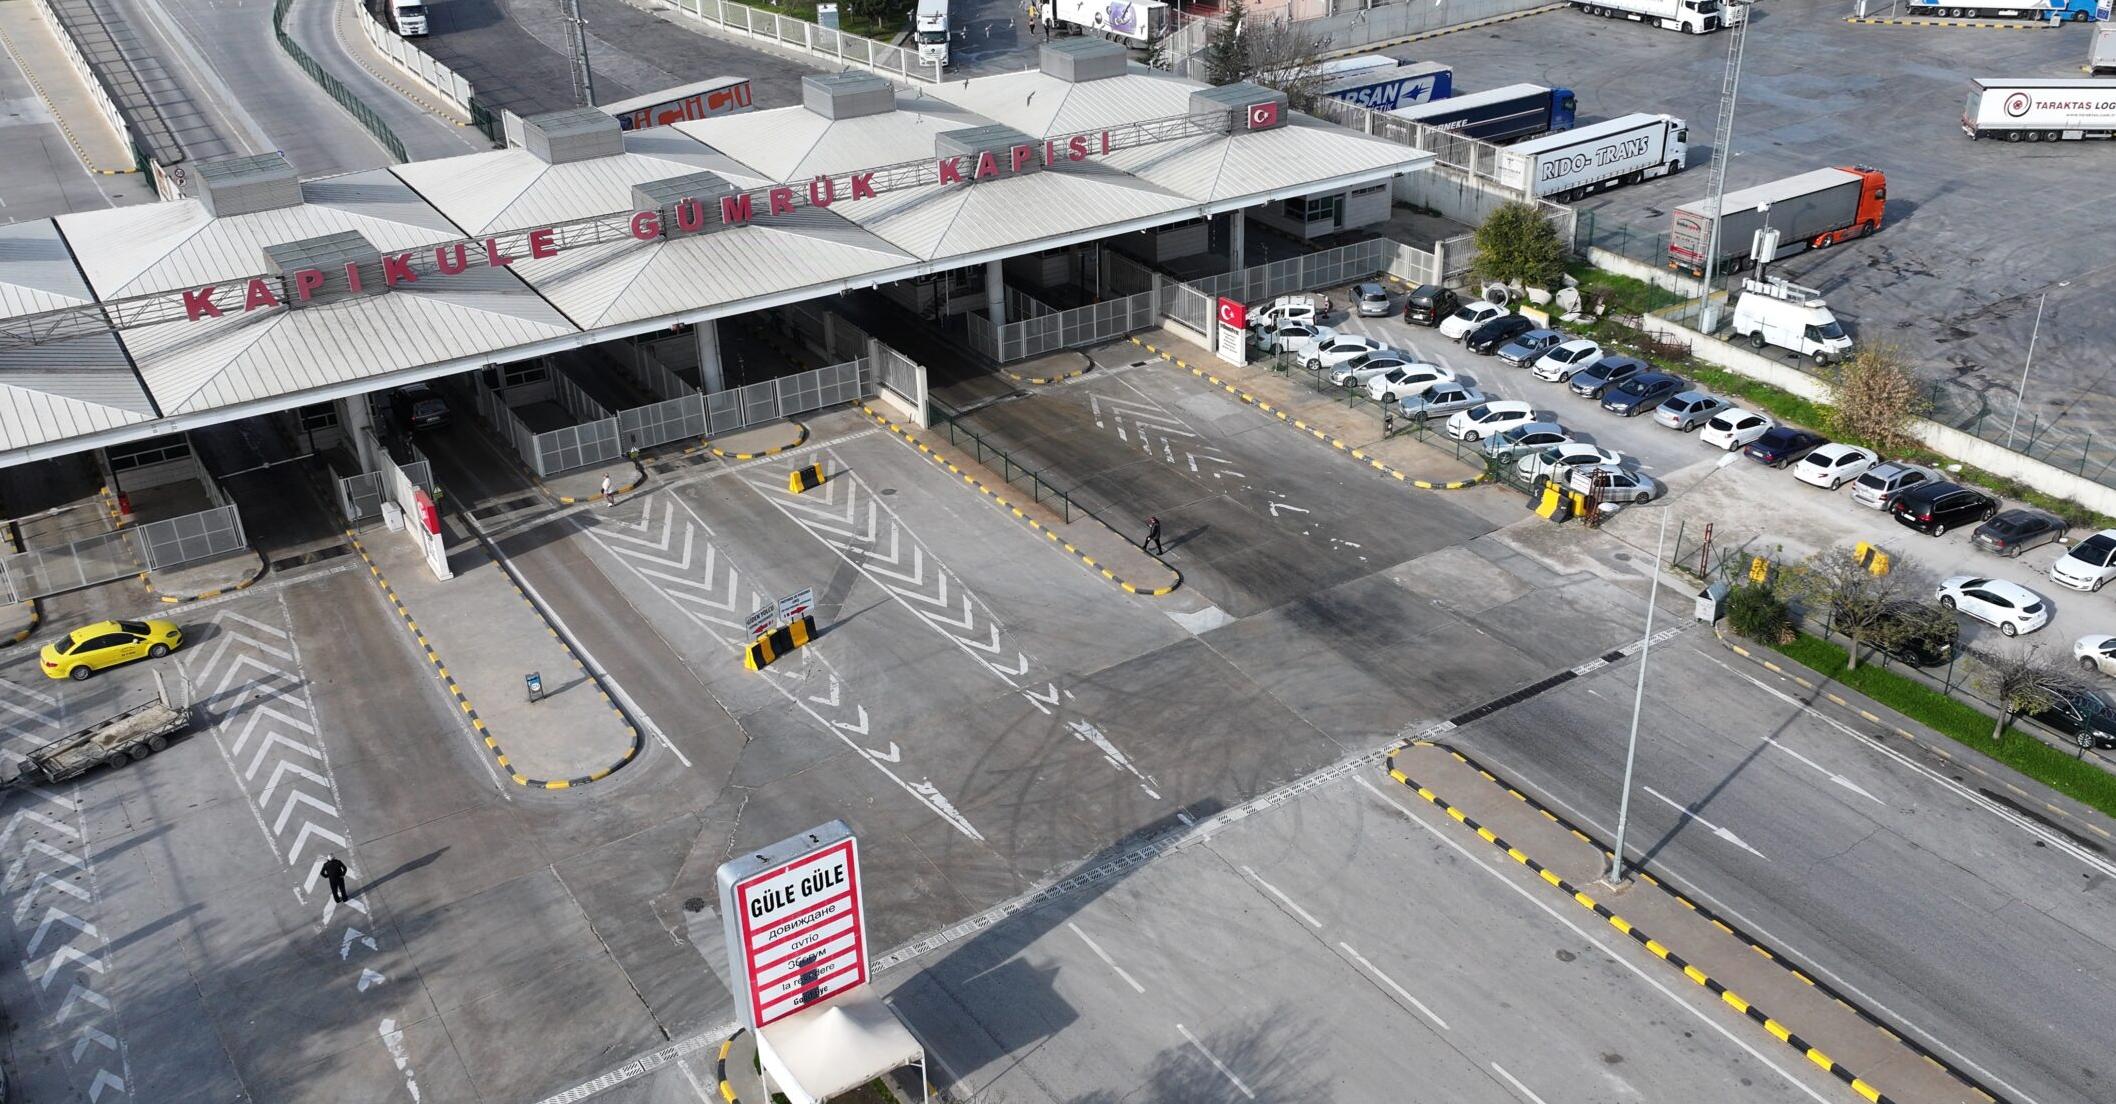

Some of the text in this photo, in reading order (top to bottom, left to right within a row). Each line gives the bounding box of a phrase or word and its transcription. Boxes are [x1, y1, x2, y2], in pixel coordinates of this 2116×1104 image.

[2035, 101, 2092, 110] TARAKTAS
[1541, 153, 1592, 181] RIDO-
[1596, 136, 1649, 167] TRANS
[182, 129, 1111, 322] KAPIKULE GÜMRÜK KAPISI
[751, 863, 844, 918] GÜLE GÜLE
[768, 904, 836, 941] довиждане
